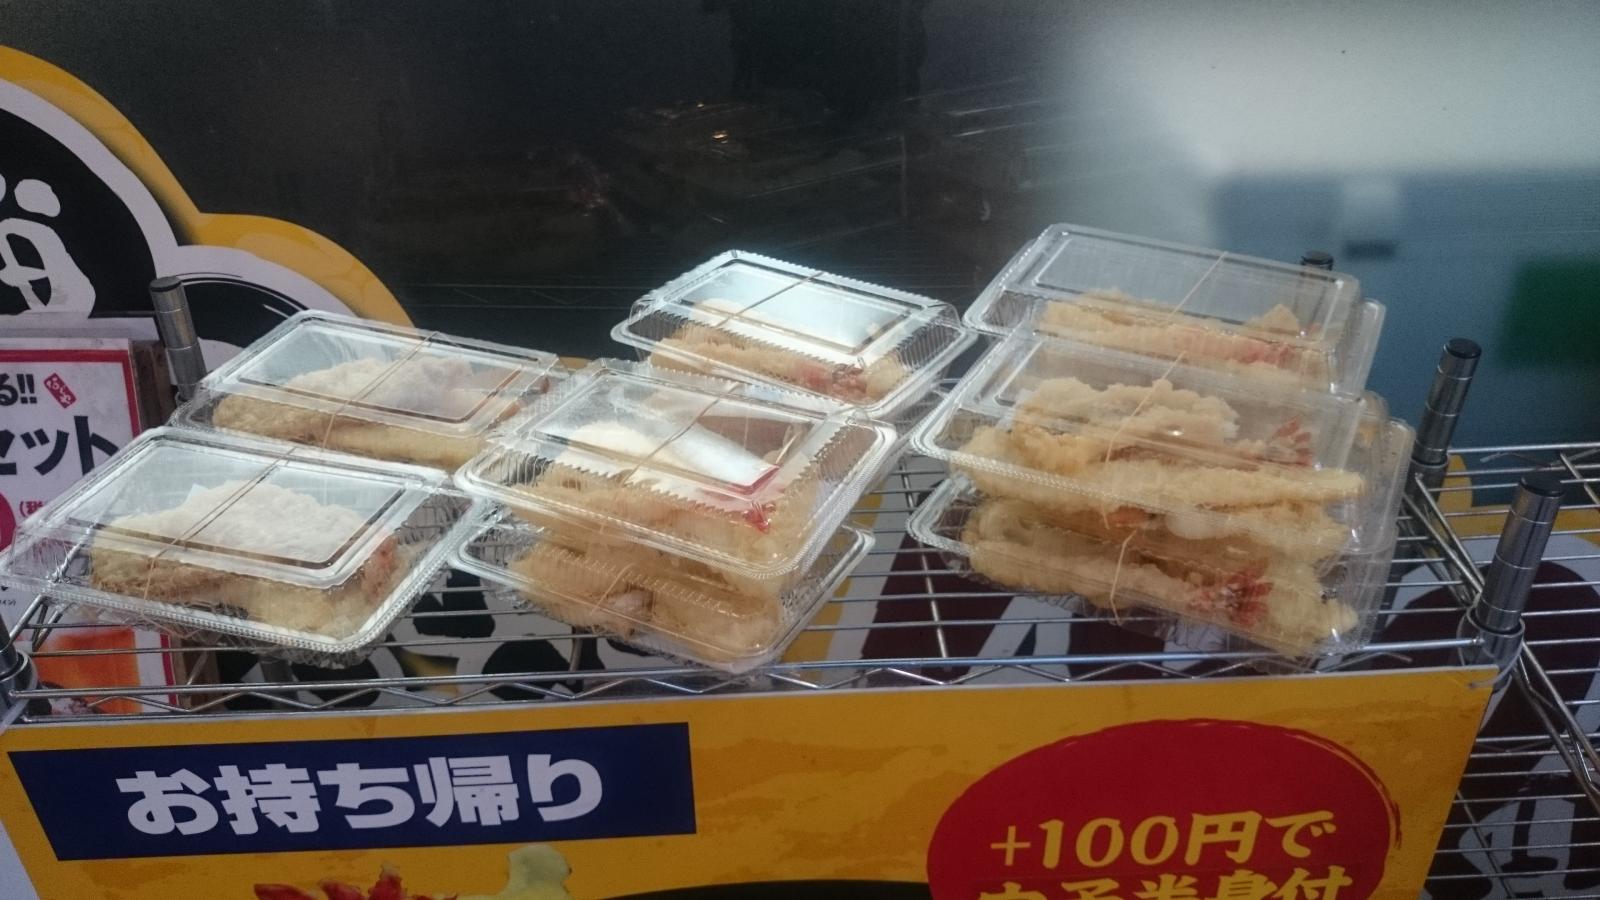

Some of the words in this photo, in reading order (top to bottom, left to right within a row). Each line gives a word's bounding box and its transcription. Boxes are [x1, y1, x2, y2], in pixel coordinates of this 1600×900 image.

[115, 753, 604, 836] お持ち帰り
[990, 809, 1337, 870] +100円で
